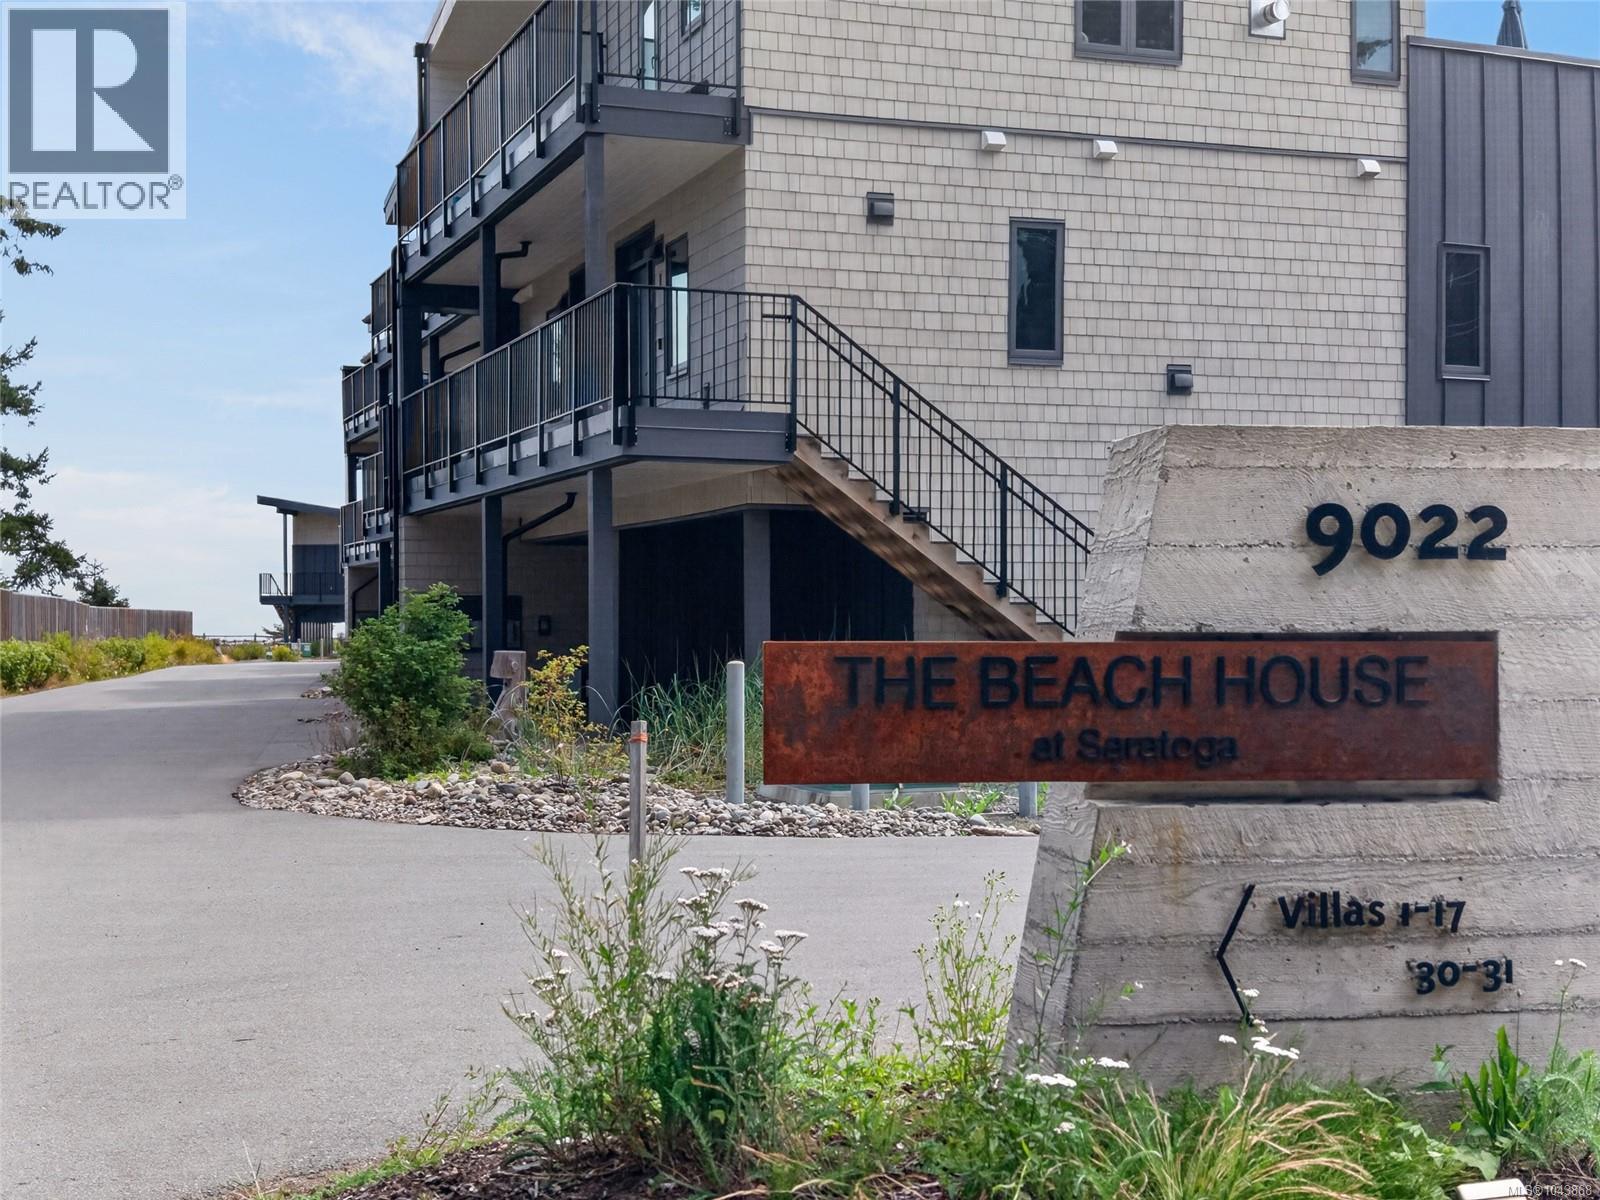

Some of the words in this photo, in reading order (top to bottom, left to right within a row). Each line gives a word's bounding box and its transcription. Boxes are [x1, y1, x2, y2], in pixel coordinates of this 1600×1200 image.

[1305, 502, 1508, 577] 9022
[834, 655, 958, 710] THE
[979, 654, 1192, 711] BEACH
[1216, 654, 1429, 710] HOUSE
[1031, 730, 1065, 761] at
[1077, 728, 1239, 768] Saratoga
[1278, 890, 1385, 929] Villas
[1400, 900, 1466, 933] 1-17
[1415, 959, 1513, 995] 30-31
